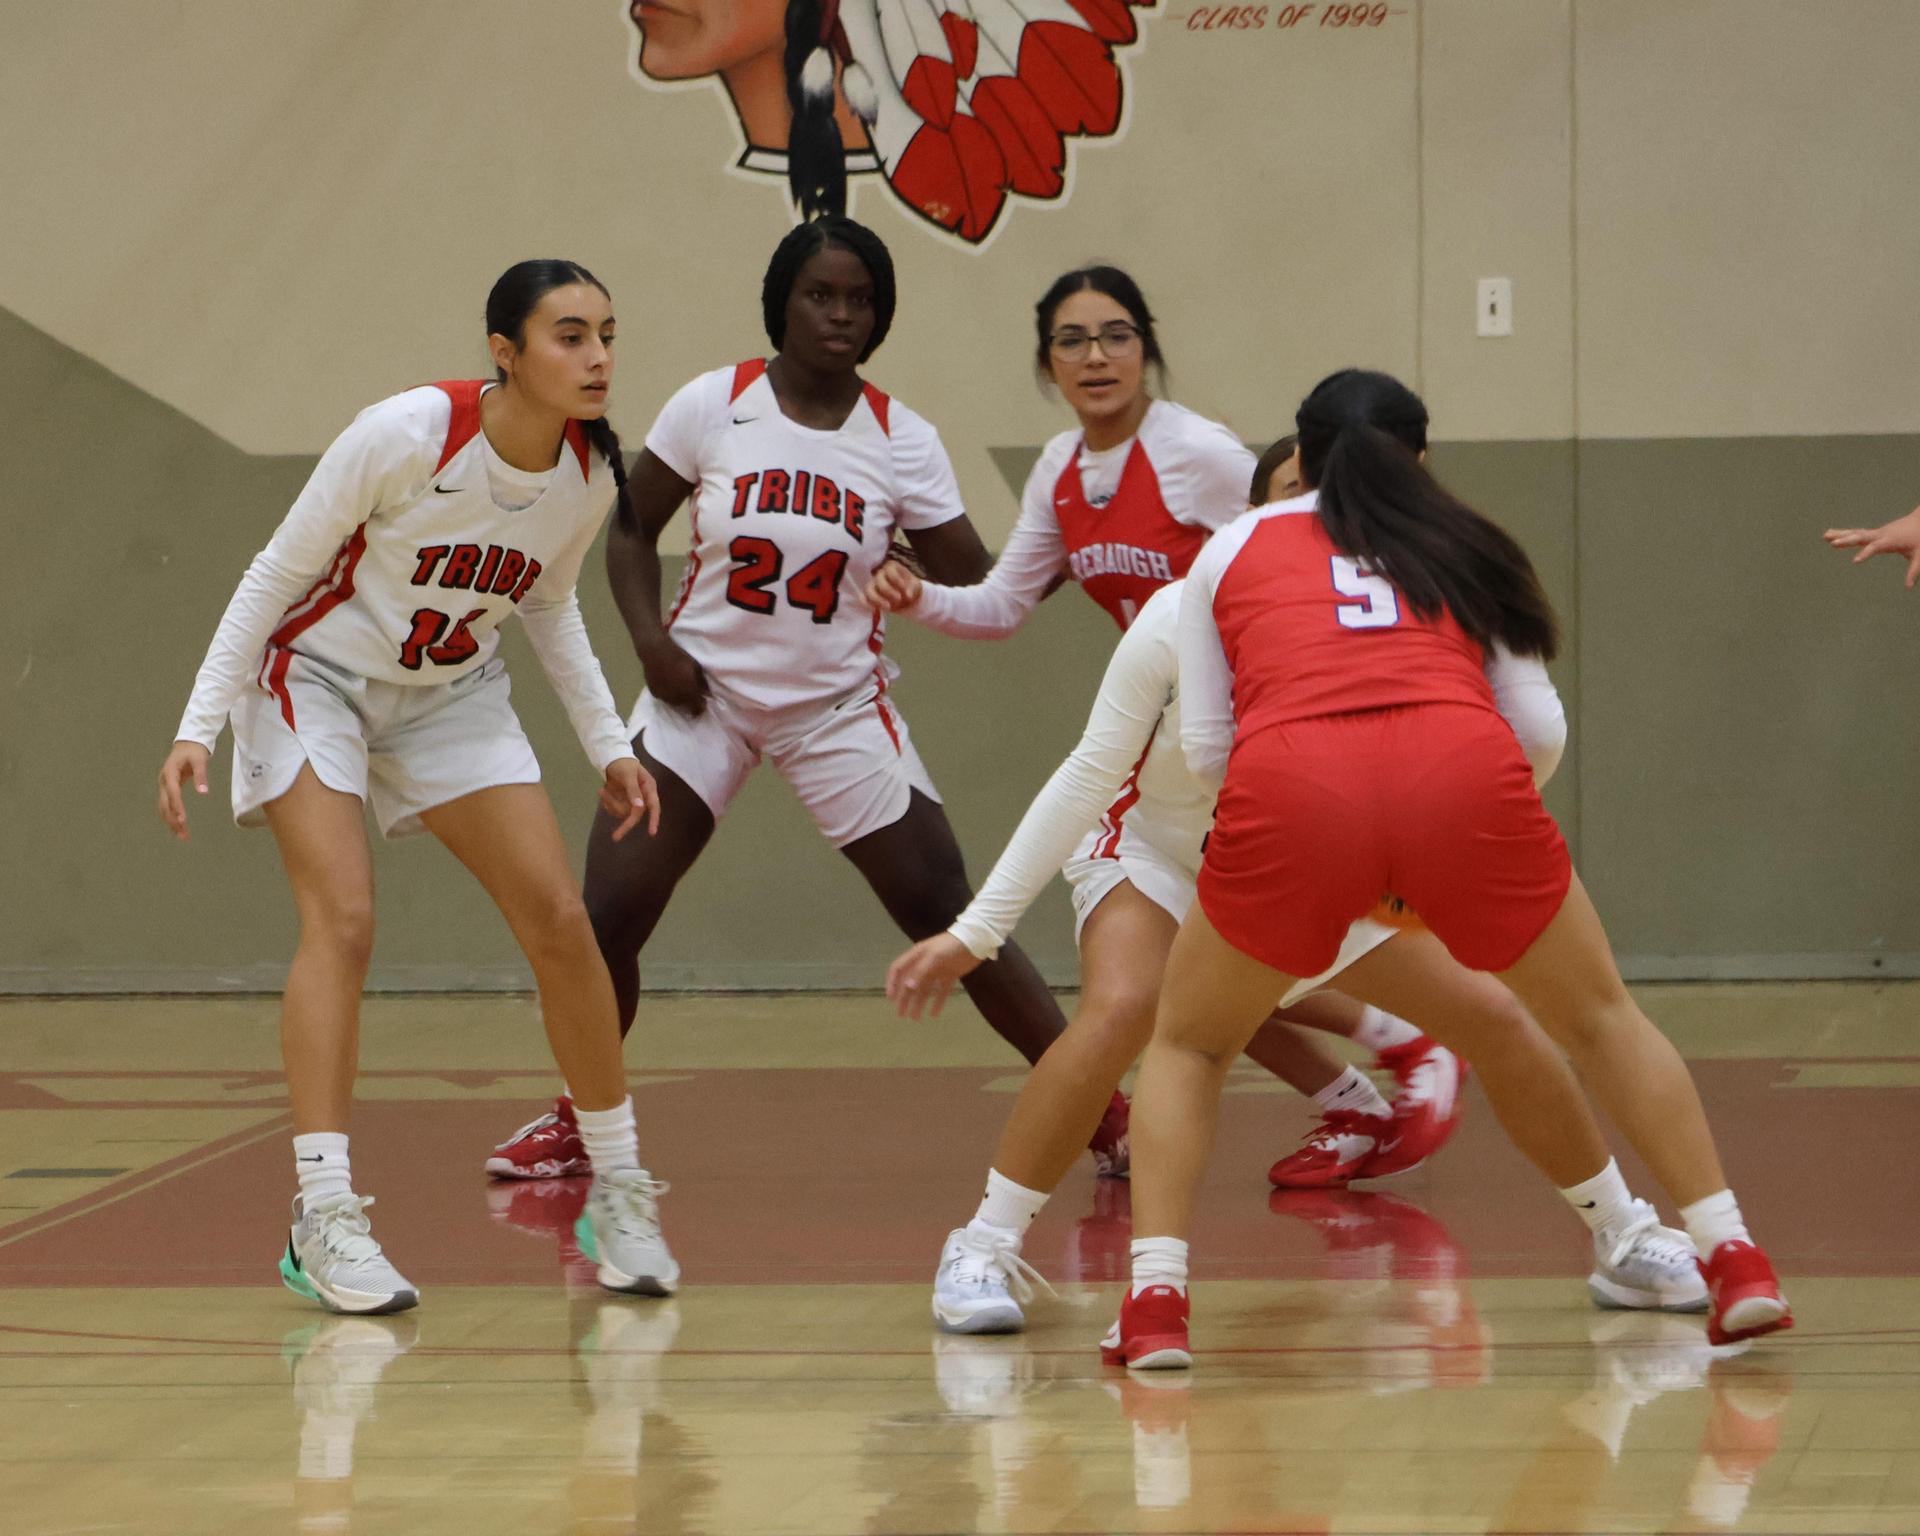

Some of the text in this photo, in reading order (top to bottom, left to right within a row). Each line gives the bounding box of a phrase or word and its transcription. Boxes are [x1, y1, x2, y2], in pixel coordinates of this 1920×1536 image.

[1187, 3, 1388, 31] CLASS OF 1999
[731, 468, 865, 545] TRIBE
[410, 544, 542, 605] TRIBE
[726, 535, 849, 624] 24
[1329, 554, 1400, 630] 5
